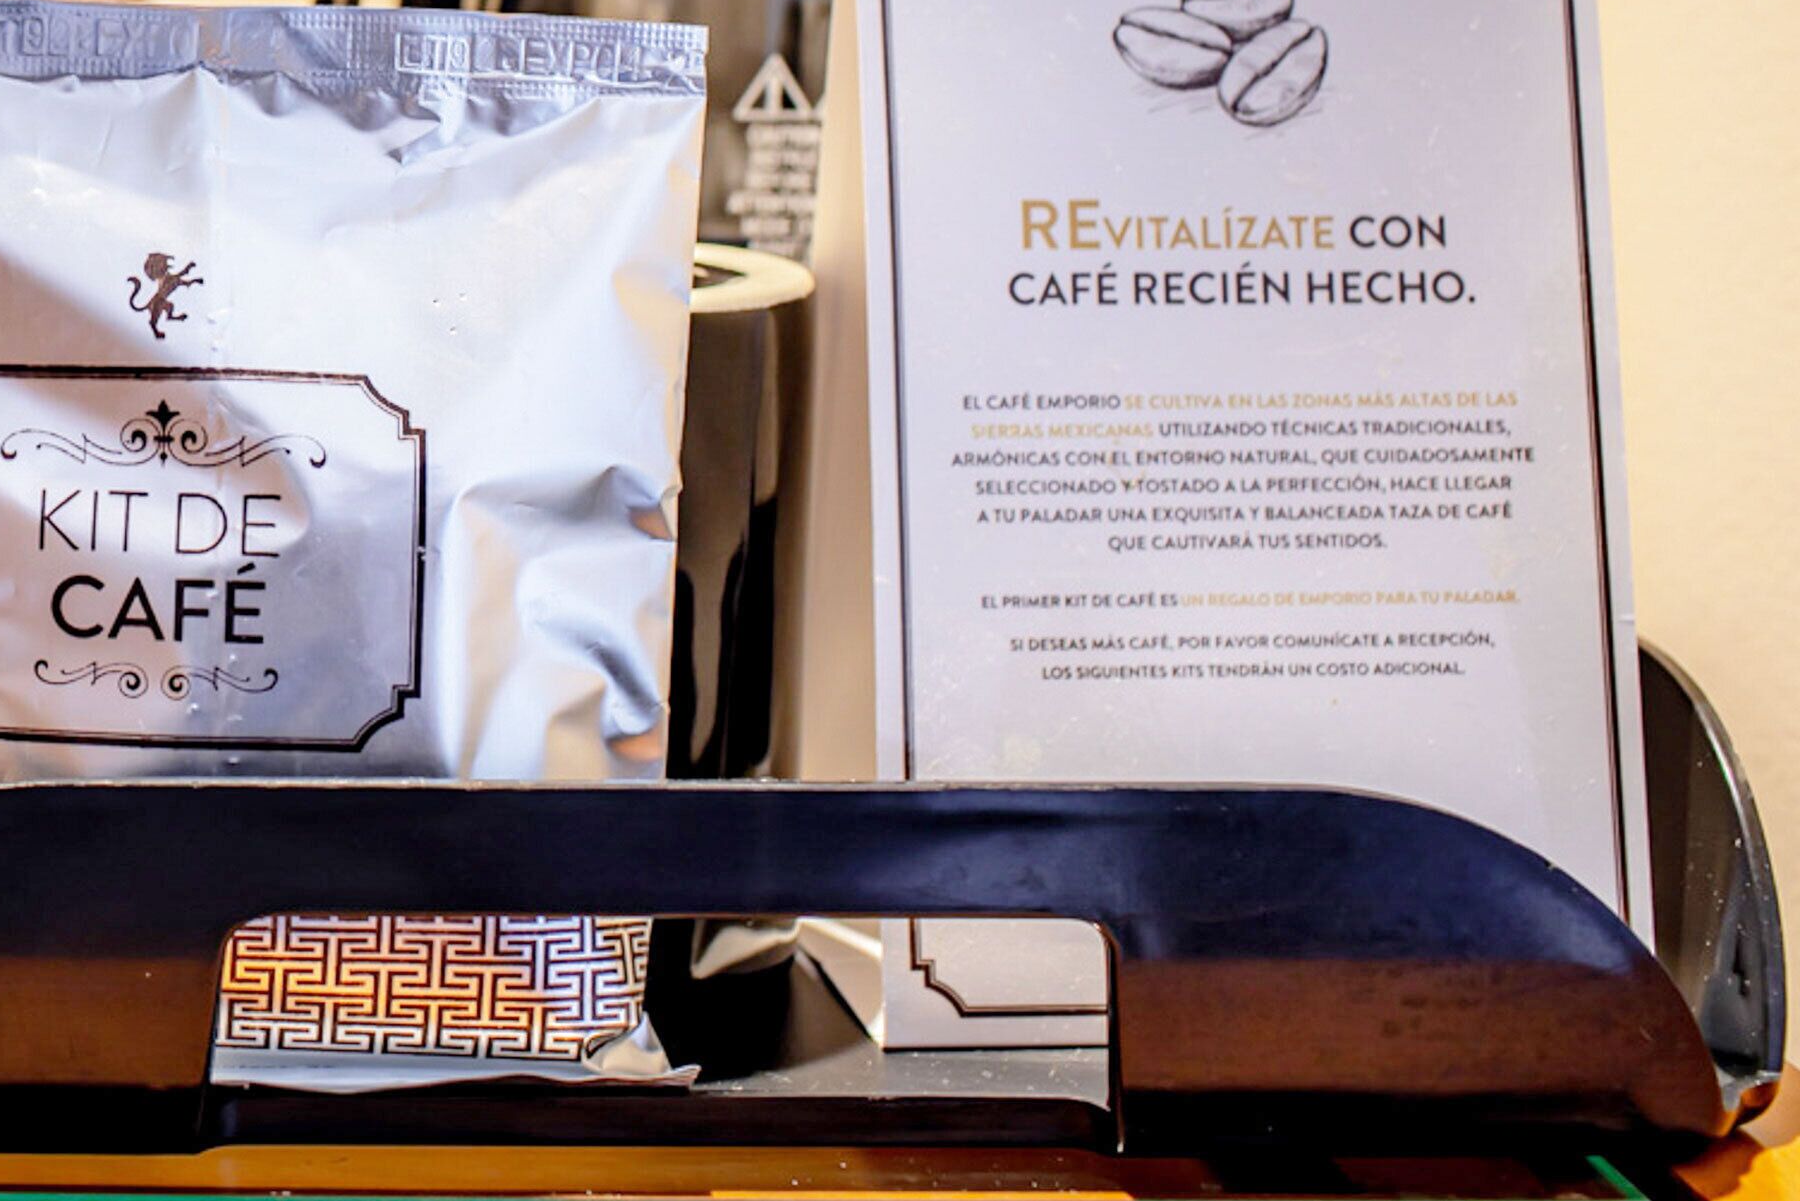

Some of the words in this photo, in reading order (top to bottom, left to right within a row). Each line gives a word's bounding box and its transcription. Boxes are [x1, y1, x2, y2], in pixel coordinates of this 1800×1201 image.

[1349, 215, 1447, 249] CON
[1008, 262, 1118, 305] CAFÉ
[1134, 262, 1290, 305] RECIÉN
[1307, 270, 1475, 305] HECHO.
[963, 395, 982, 410] EL
[986, 392, 1031, 410] CAFÉ
[1036, 395, 1120, 410] EMPORIO
[1149, 394, 1223, 409] CULTIVA
[1228, 394, 1251, 409] EN
[1257, 393, 1287, 408] LAS
[1293, 393, 1352, 408] ZONAS
[1357, 389, 1394, 408] MÁS
[1399, 393, 1452, 407] ALTAS
[1457, 392, 1480, 407] DE
[1485, 392, 1518, 407] LAS
[1159, 422, 1266, 437] UTILIZANDO
[1272, 418, 1358, 436] TÉCNICAS
[952, 449, 1060, 467] ARMÓNICAS
[1065, 452, 1107, 466] CON
[1136, 451, 1224, 466] ENTORNO
[1321, 449, 1358, 466] QUE
[1364, 447, 1535, 464] CUIDADOSAMENTE
[975, 480, 1116, 495] SELECCIONADO
[1224, 479, 1236, 493] A
[1240, 478, 1261, 492] LA
[1391, 476, 1439, 491] HACE
[1444, 475, 1512, 490] LLEGAR
[977, 509, 989, 523] A
[993, 509, 1015, 523] TU
[1020, 508, 1102, 522] PALADAR
[1108, 508, 1147, 522] UNA
[1152, 506, 1244, 523] EXQUISITA
[1249, 506, 1259, 520] Y
[1265, 505, 1384, 520] BALANCEADA
[1389, 504, 1431, 519] TAZA
[1437, 504, 1460, 518] DE
[1466, 500, 1513, 518] CAFÉ
[39, 489, 149, 552] KIT
[175, 492, 281, 558] DE
[1108, 536, 1146, 553] QUE
[1258, 534, 1291, 549] TUS
[51, 562, 266, 644] CAFÉ
[981, 596, 998, 609] EL
[1002, 595, 1060, 609] PRIMER
[1064, 594, 1088, 607] KIT
[1092, 594, 1110, 607] DE
[1116, 592, 1155, 607] CAFÉ
[1161, 594, 1178, 606] ES
[1010, 638, 1023, 651] SI
[1028, 638, 1088, 651] DESEAS
[1091, 634, 1125, 650] MÁS
[1178, 637, 1210, 649] POR
[1215, 635, 1269, 648] FAVOR
[1383, 634, 1394, 647] A
[1041, 666, 1072, 680] LOS
[1076, 665, 1167, 679] SIGUIENTES
[1172, 665, 1204, 678] KITS
[1288, 663, 1311, 676] UN
[1316, 662, 1369, 676] COSTO
